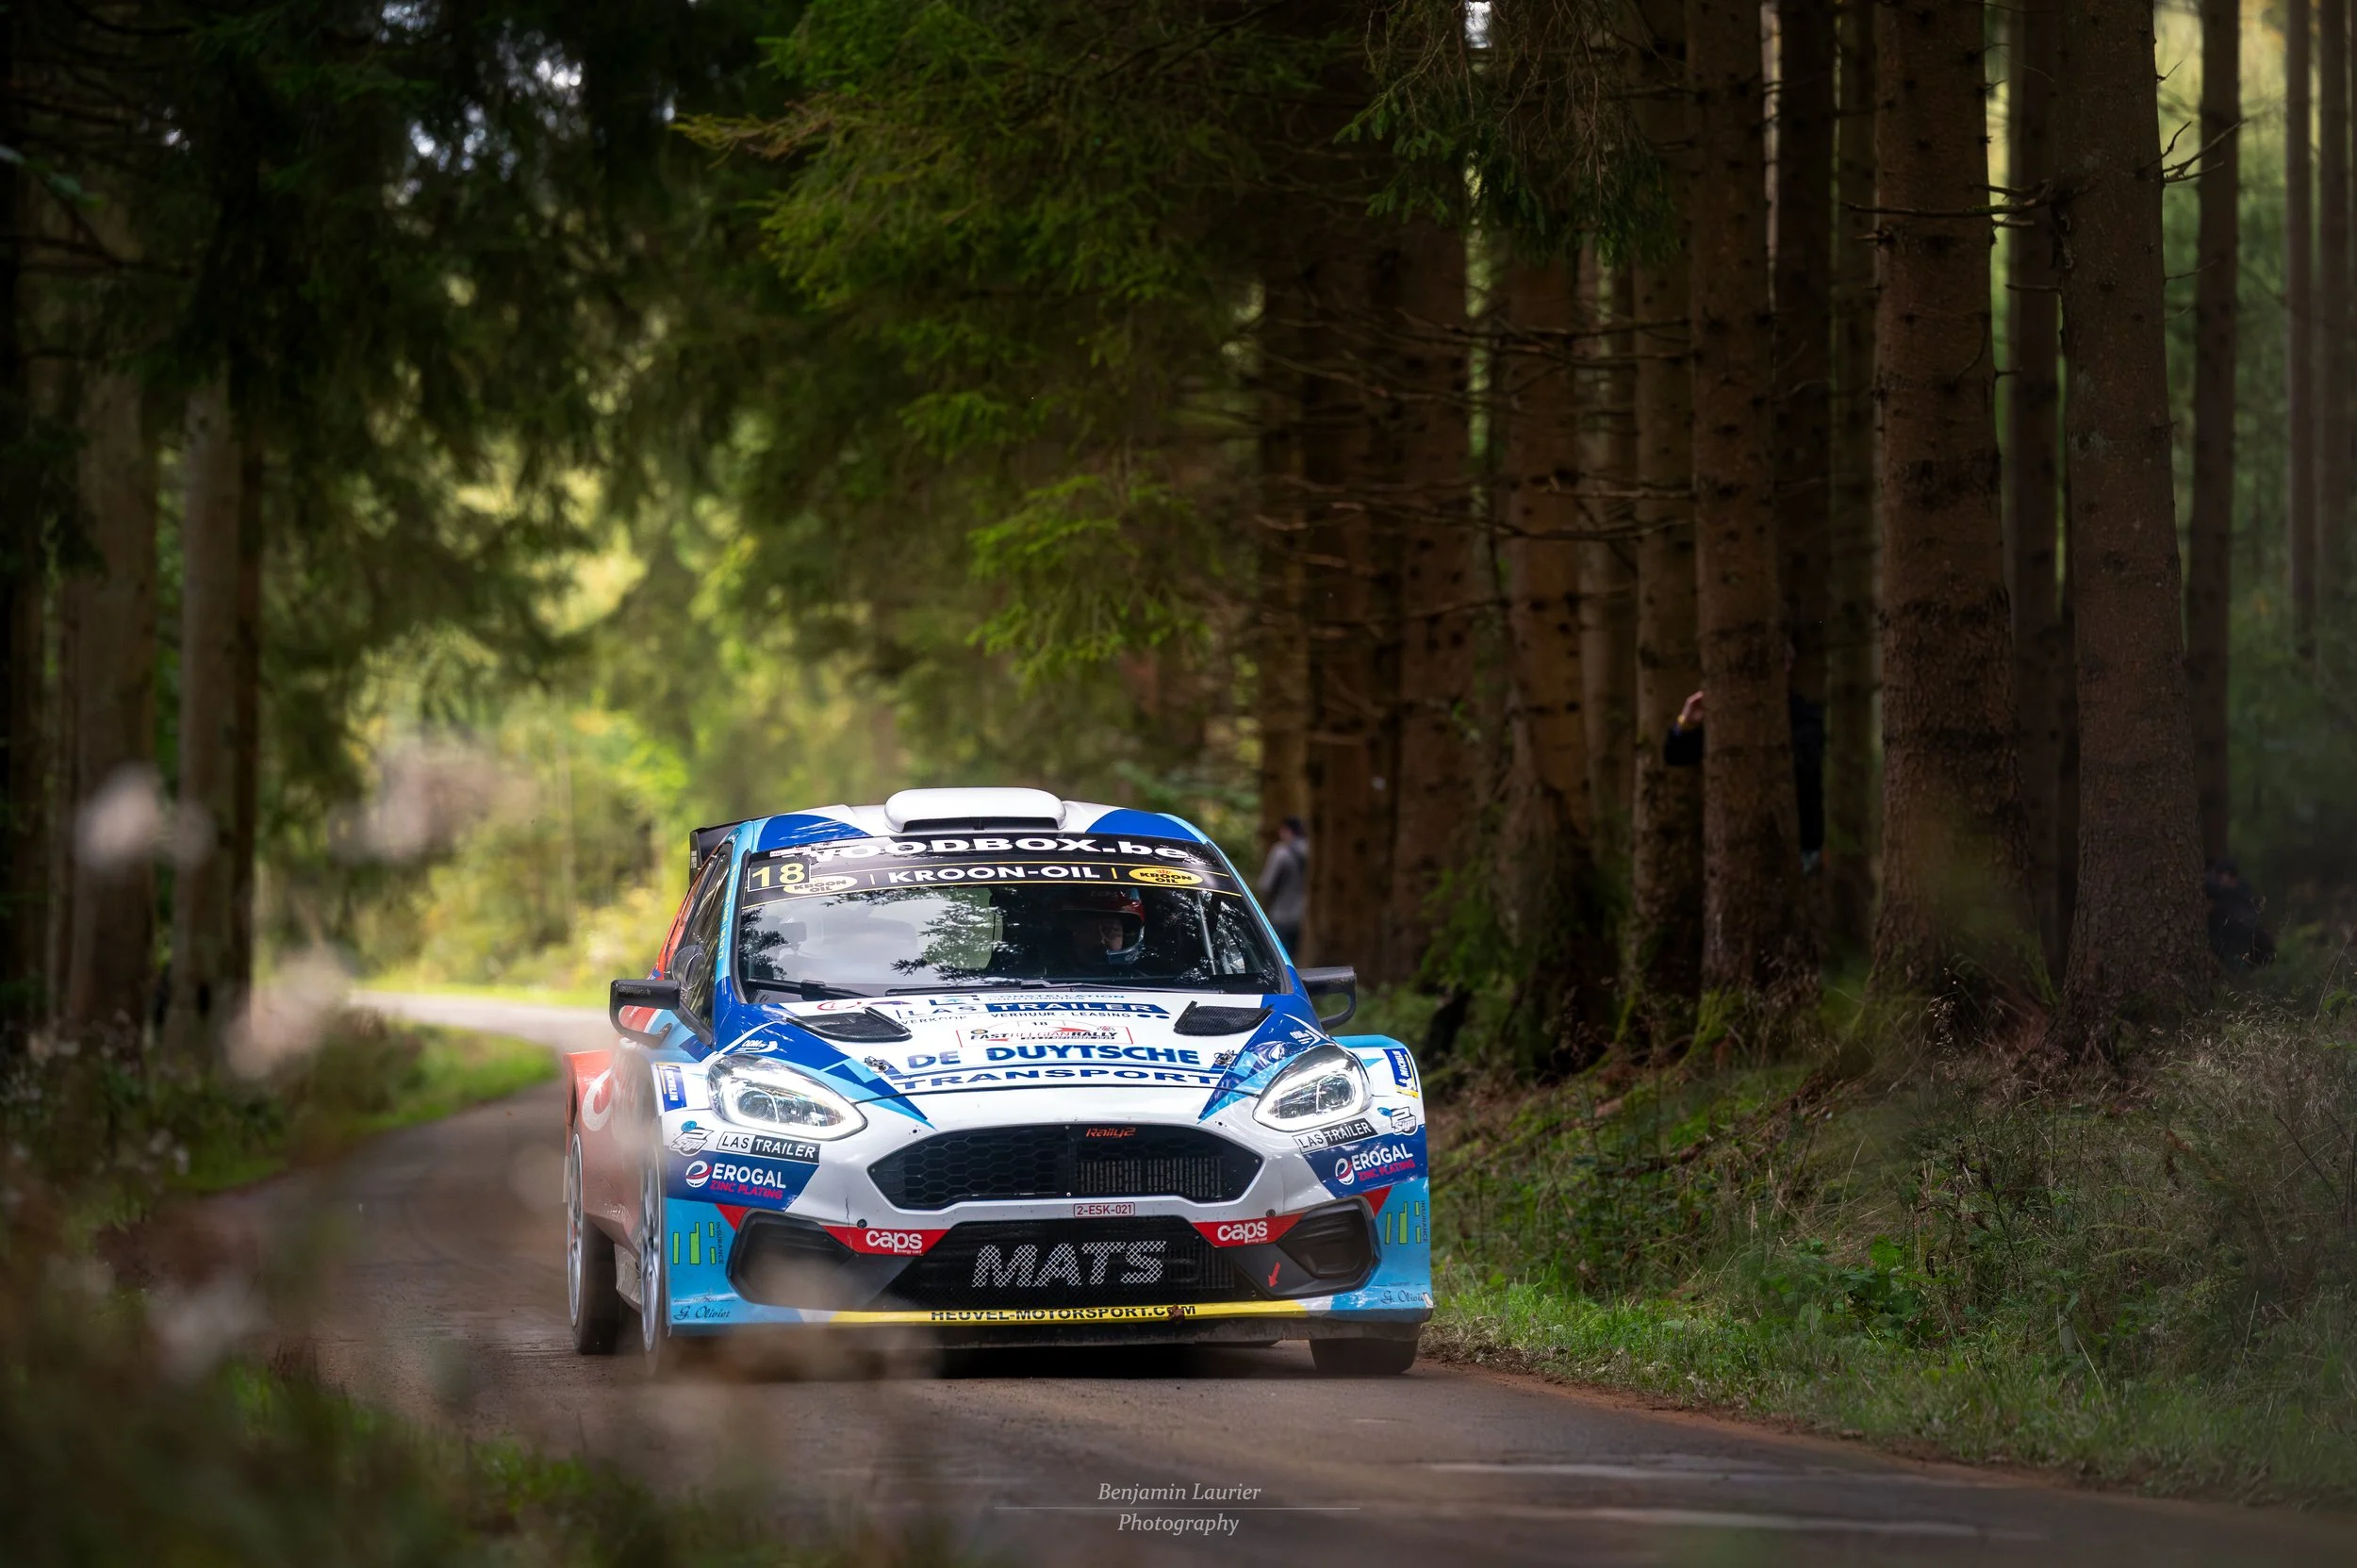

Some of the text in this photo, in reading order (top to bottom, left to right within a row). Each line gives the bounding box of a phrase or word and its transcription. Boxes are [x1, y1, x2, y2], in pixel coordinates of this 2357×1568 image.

[751, 862, 805, 888] 18
[793, 879, 848, 890] KROON
[888, 866, 1100, 884] KROON-OIL
[1139, 872, 1193, 881] KROON
[908, 1002, 1153, 1015] LAS TRAILER
[908, 1044, 1201, 1069] DE DUYTSCHE
[1393, 1050, 1409, 1078] MICHELIN
[894, 1069, 1220, 1090] TRANSPORT
[1086, 1127, 1137, 1140] Rally2
[1298, 1122, 1372, 1148] LAS TRAILER
[721, 1134, 816, 1159] LAS TRAILER
[1352, 1143, 1413, 1172] EROGAL
[712, 1163, 786, 1189] EROGAL
[709, 1180, 783, 1200] ZINC PLATING
[1077, 1204, 1132, 1214] 2-ESK-021
[716, 1221, 725, 1265] INSURANCE
[865, 1230, 923, 1253] caps
[1217, 1220, 1268, 1244] caps
[972, 1240, 1167, 1288] MATS
[931, 1304, 1196, 1321] HEUVEL-MOTORSPORT.CM
